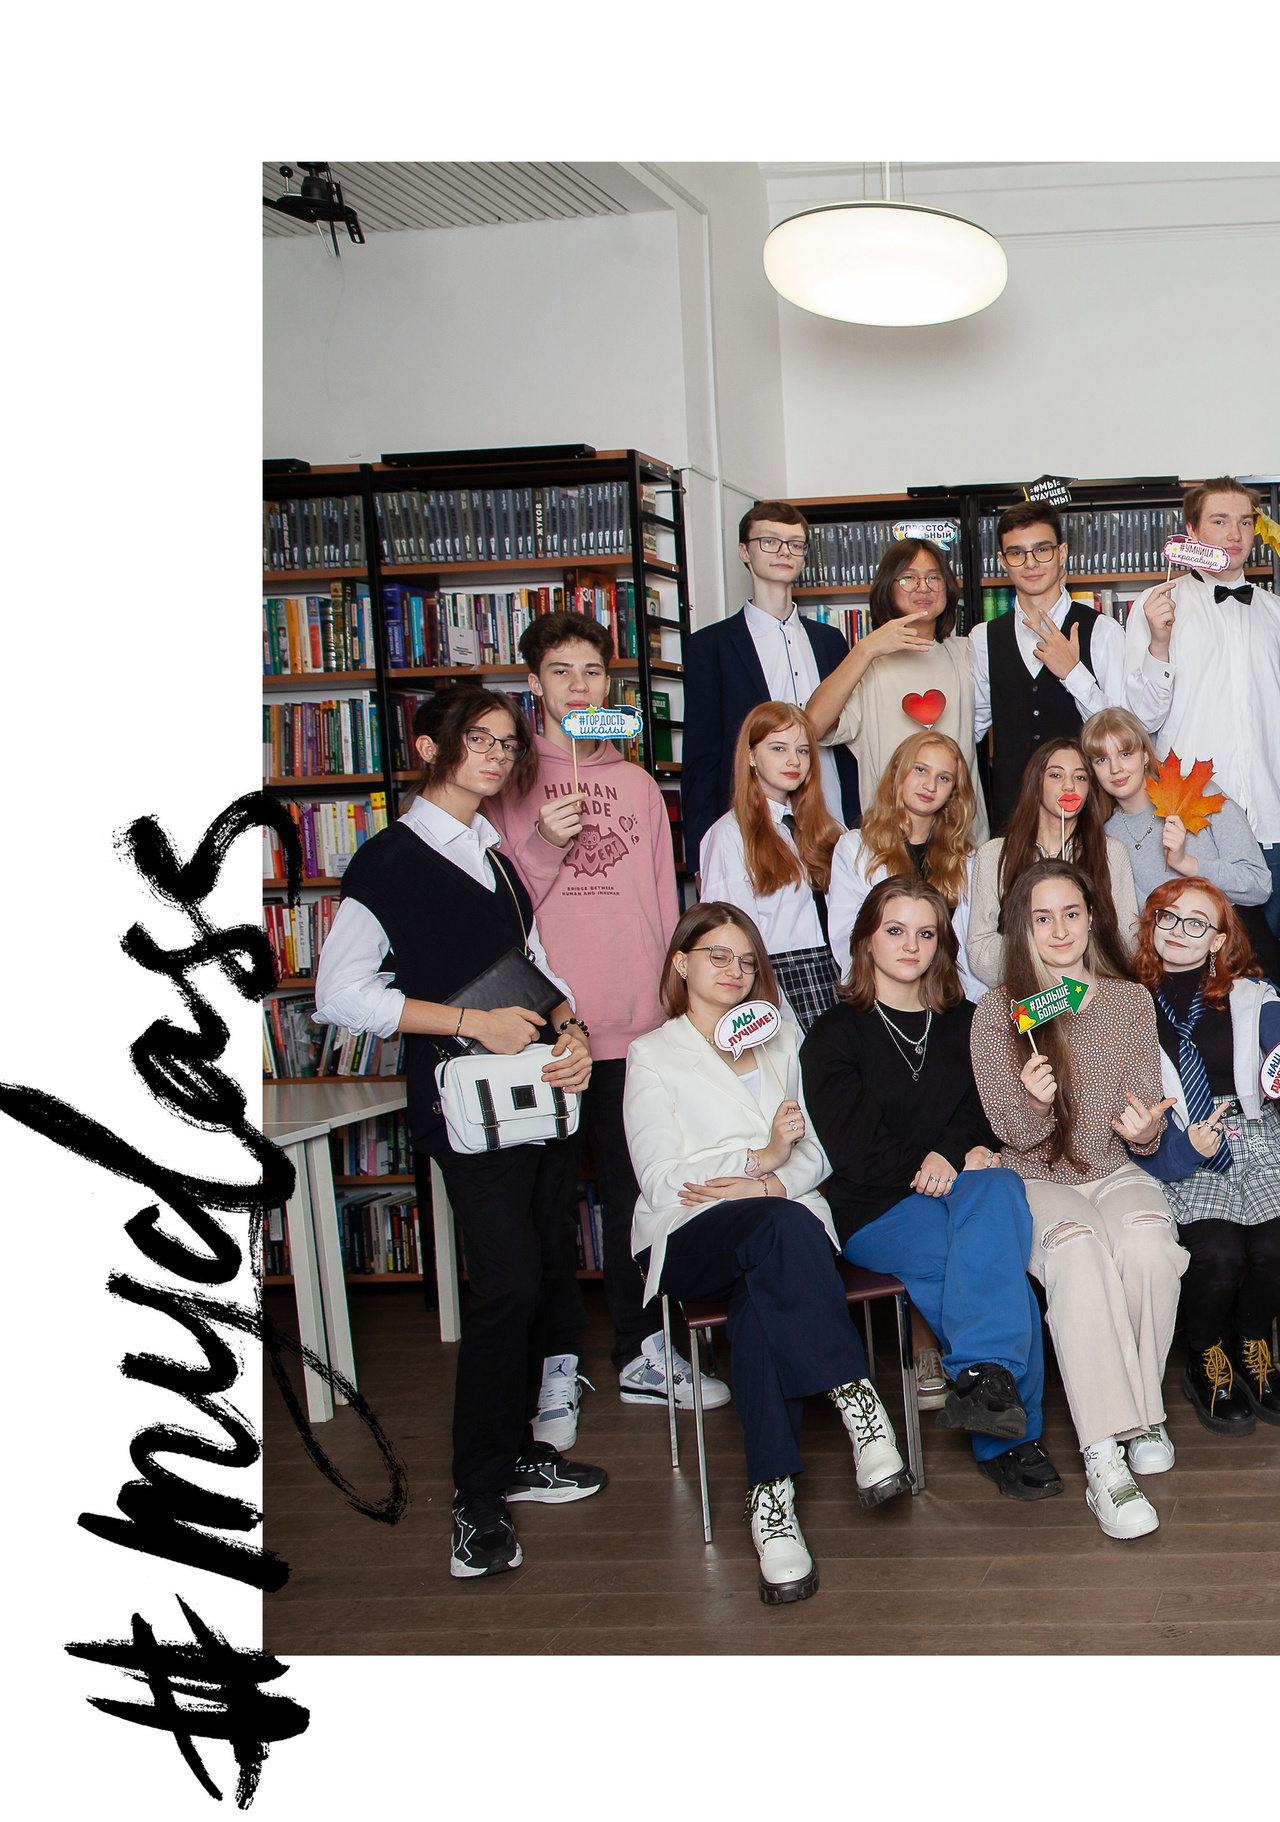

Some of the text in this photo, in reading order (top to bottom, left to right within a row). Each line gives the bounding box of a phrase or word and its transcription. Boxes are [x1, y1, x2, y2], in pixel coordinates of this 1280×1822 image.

[1030, 487, 1067, 502] БУДУЩЕЕ
[535, 503, 544, 536] ЖУКОВ
[1180, 544, 1214, 558] #УМНИЦА
[579, 715, 626, 726] #ГОРДОСТЬ
[580, 726, 626, 735] школы
[544, 782, 618, 800] HUMAN
[578, 800, 612, 818] ADE
[1029, 984, 1070, 1012] #ДАЛЬШЕ
[1037, 998, 1070, 1020] БОЛЬШЕ
[728, 1012, 774, 1047] ЛУЧШИЕ!
[1267, 1053, 1280, 1078] НАШ
